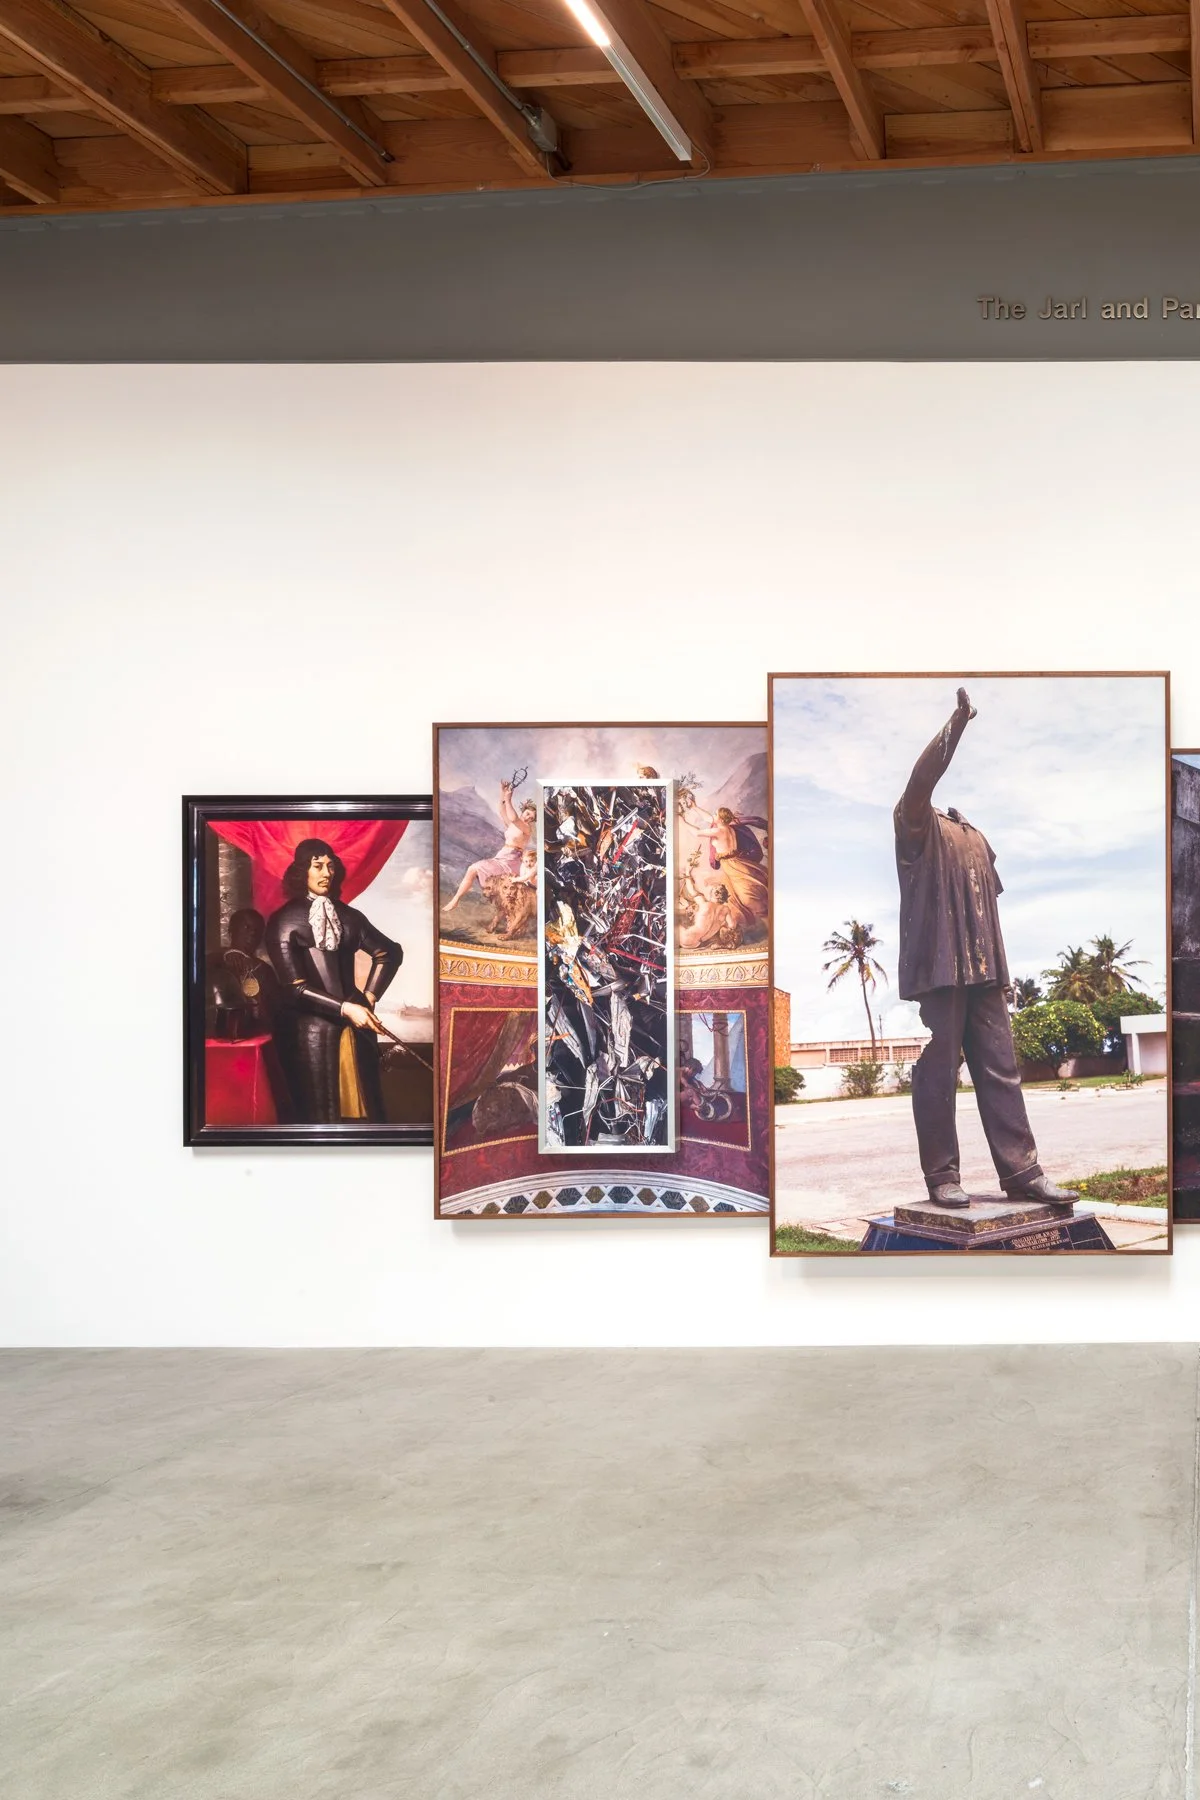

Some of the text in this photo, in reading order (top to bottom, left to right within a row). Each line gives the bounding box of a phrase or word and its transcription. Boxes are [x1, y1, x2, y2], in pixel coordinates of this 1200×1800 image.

[977, 298, 1027, 320] The
[1038, 298, 1088, 320] Jarl
[1101, 298, 1149, 320] and
